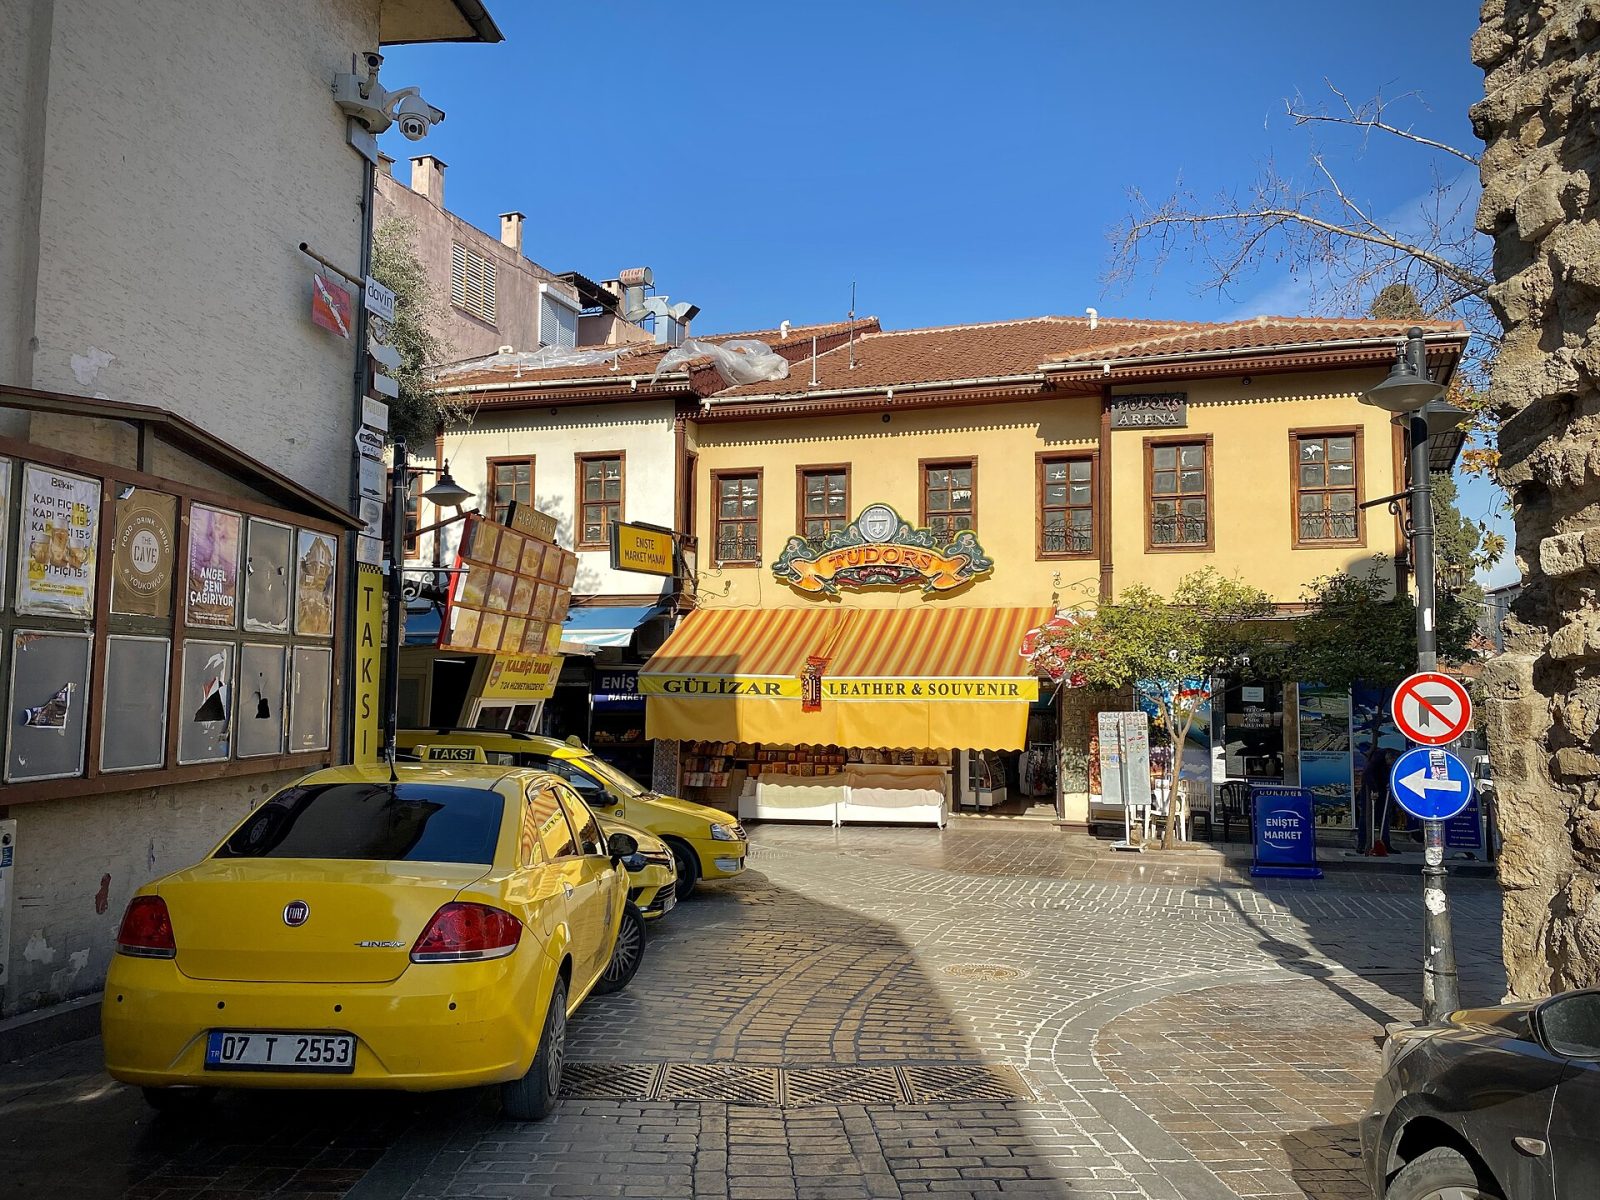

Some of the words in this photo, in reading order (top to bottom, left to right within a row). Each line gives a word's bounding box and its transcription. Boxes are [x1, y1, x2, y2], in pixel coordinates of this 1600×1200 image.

[1118, 413, 1179, 425] ARENA
[33, 493, 55, 507] KAPI
[32, 507, 55, 520] KAPI
[31, 521, 53, 535] KAP
[136, 516, 156, 527] DRINK
[159, 527, 170, 554] MUSIC
[142, 536, 152, 545] THE
[134, 545, 157, 564] CAVE
[828, 548, 932, 571] TUDORS
[29, 562, 52, 575] KAPI
[200, 567, 227, 582] ANGEL
[361, 586, 374, 755] TAKSI
[663, 677, 782, 696] GÜLİZAR
[829, 683, 907, 696] LEATHER
[911, 683, 923, 696] &
[928, 683, 1020, 696] SOUVENIR
[1265, 816, 1299, 829] ENİŞTE
[1264, 830, 1302, 840] MARKET
[288, 907, 304, 919] FIAT
[210, 1050, 220, 1058] TR
[222, 1036, 250, 1061] 07
[266, 1037, 278, 1062] T
[294, 1038, 350, 1063] 2553
